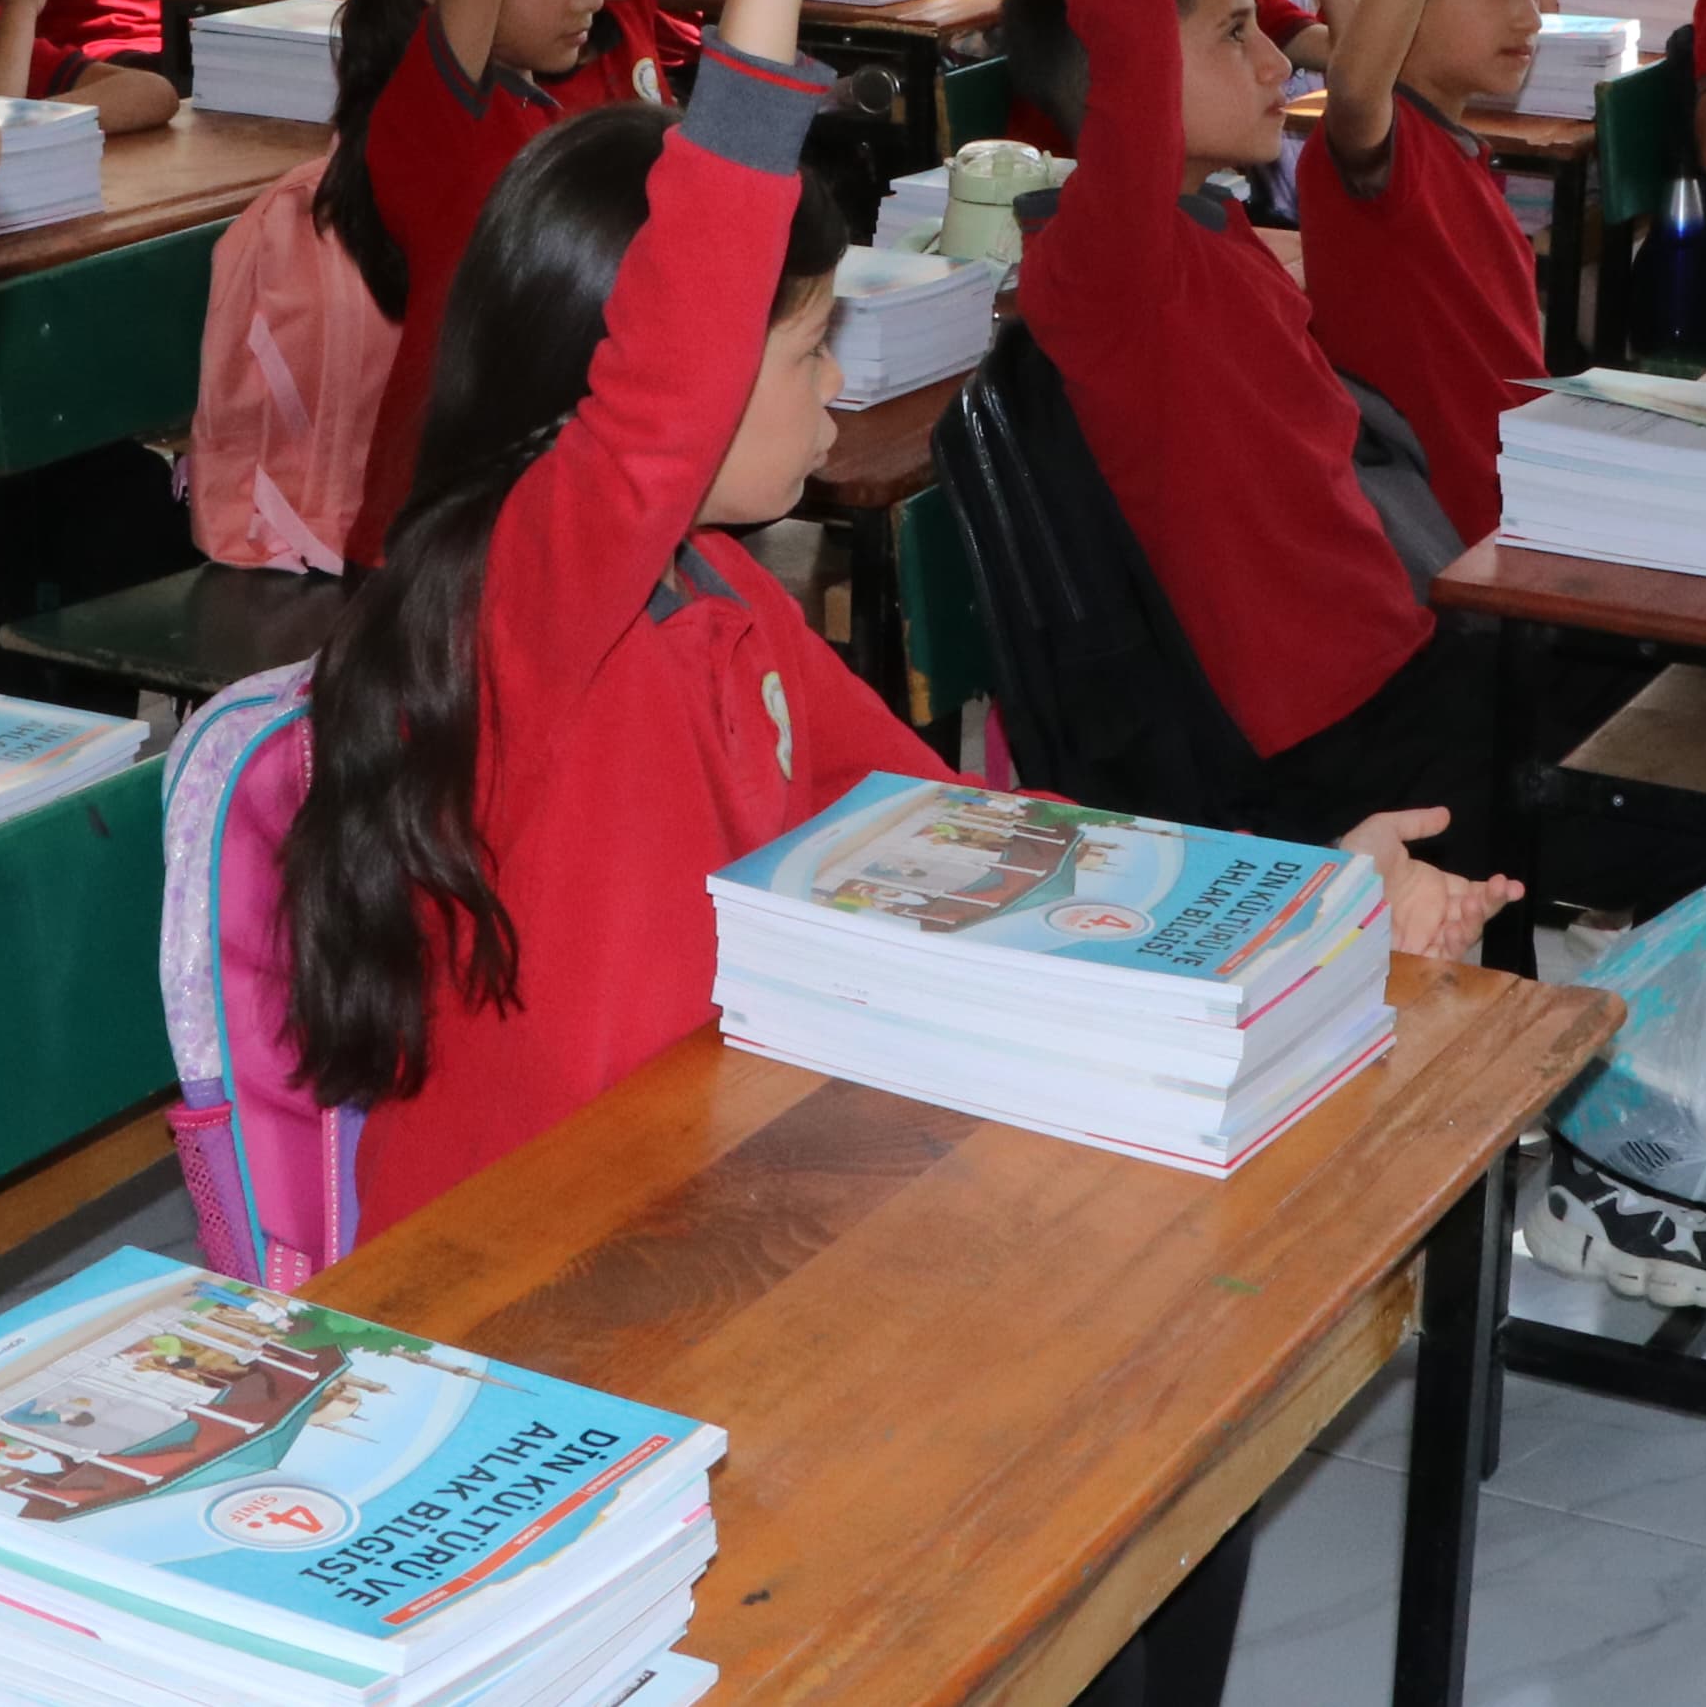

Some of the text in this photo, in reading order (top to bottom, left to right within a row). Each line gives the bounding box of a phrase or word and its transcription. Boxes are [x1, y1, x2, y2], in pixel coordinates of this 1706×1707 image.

[1135, 858, 1258, 958] AHLAK BİLGİSİ
[1170, 859, 1303, 968] DİN KÜLTÜRÜ VE
[434, 1421, 559, 1502] AHLAK
[541, 1429, 620, 1474] DİN
[228, 1494, 278, 1523] SINIF
[247, 1504, 325, 1534] 4.
[296, 1500, 452, 1588] BİLGİSİ
[389, 1473, 556, 1581] KÜLTÜRÜ
[336, 1577, 406, 1608] VE
